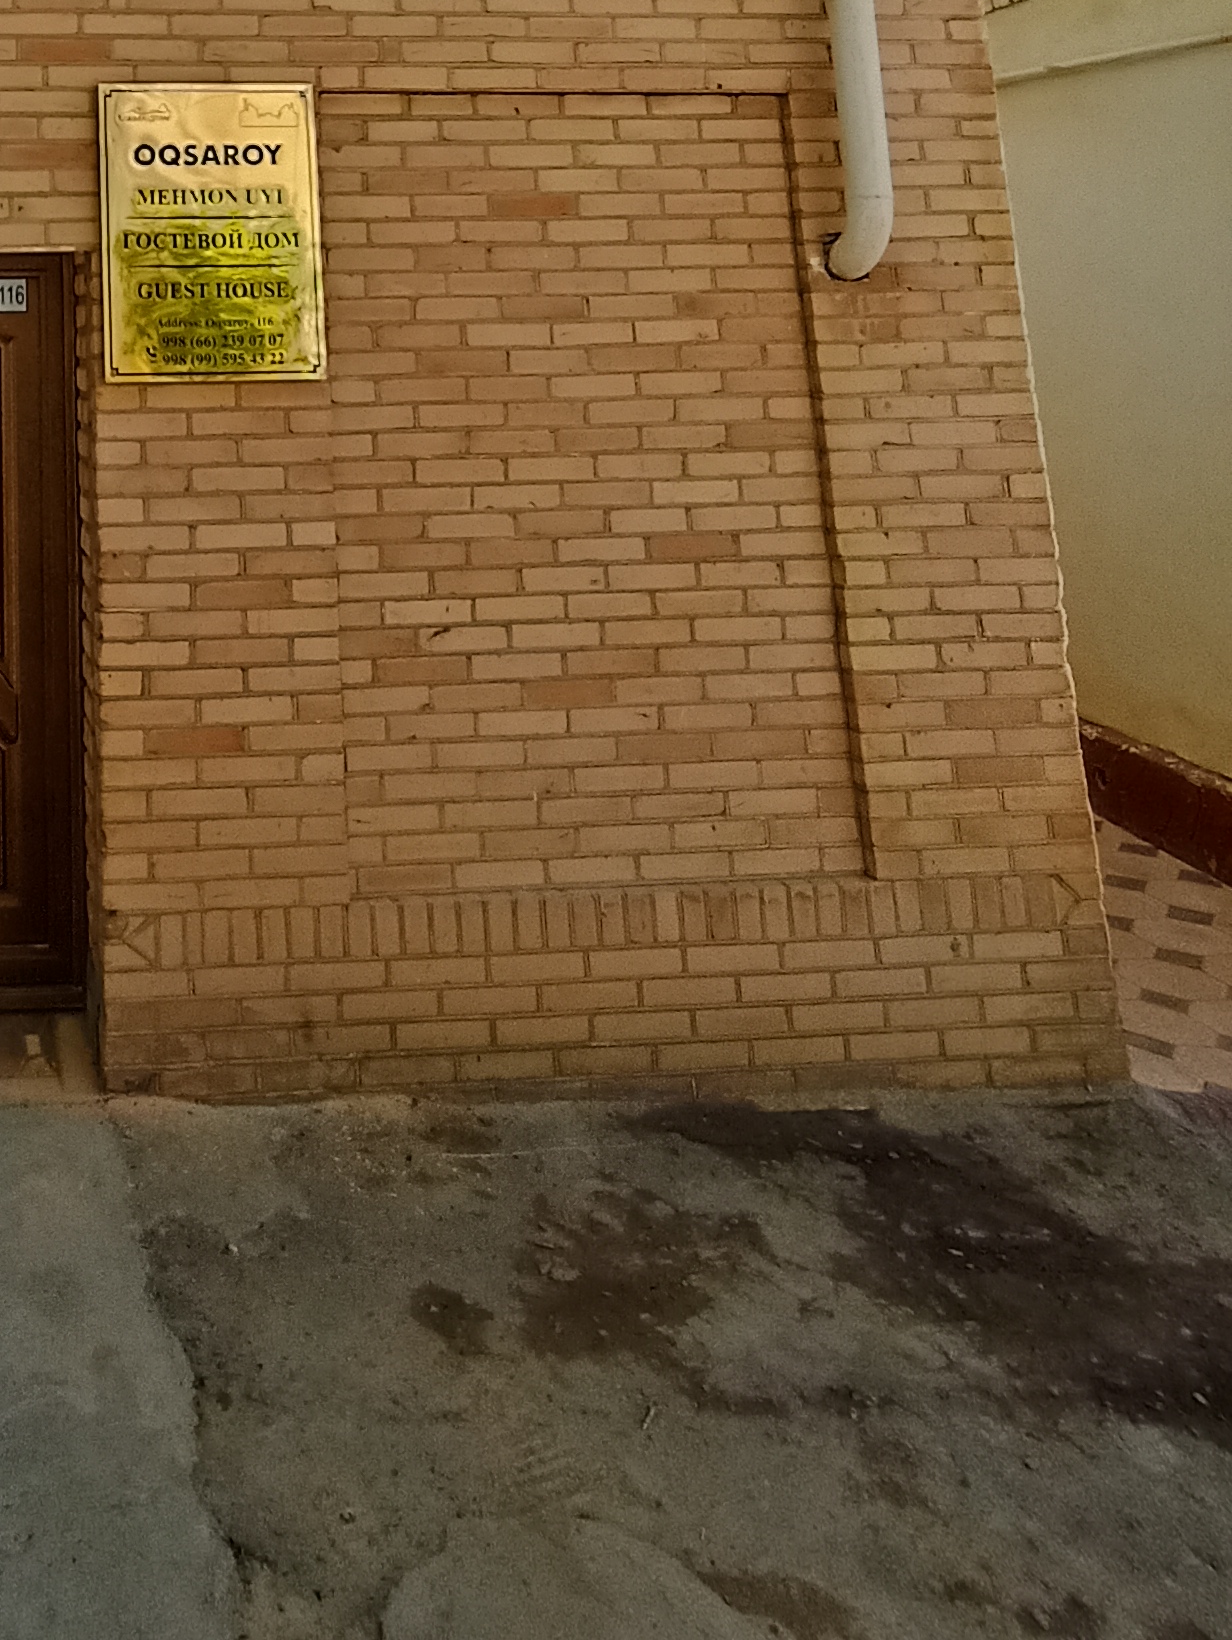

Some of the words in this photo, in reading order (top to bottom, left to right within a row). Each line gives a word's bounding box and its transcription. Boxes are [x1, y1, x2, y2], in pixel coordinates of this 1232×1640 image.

[133, 143, 282, 167] OQSAROY
[136, 189, 238, 206] MEHMON
[246, 188, 283, 205] UYI
[123, 228, 243, 250] ГОСТЕВОЙ
[249, 232, 300, 251] ДОМ
[0, 285, 25, 305] 116
[137, 282, 211, 300] GUEST
[215, 281, 290, 300] HOUSE
[256, 317, 274, 327] 116
[162, 336, 186, 348] 998
[221, 334, 245, 348] 239
[248, 334, 265, 347] 07
[268, 333, 284, 347] 07
[190, 353, 218, 367] (99)
[221, 352, 245, 366] 595
[270, 352, 285, 365] 22
